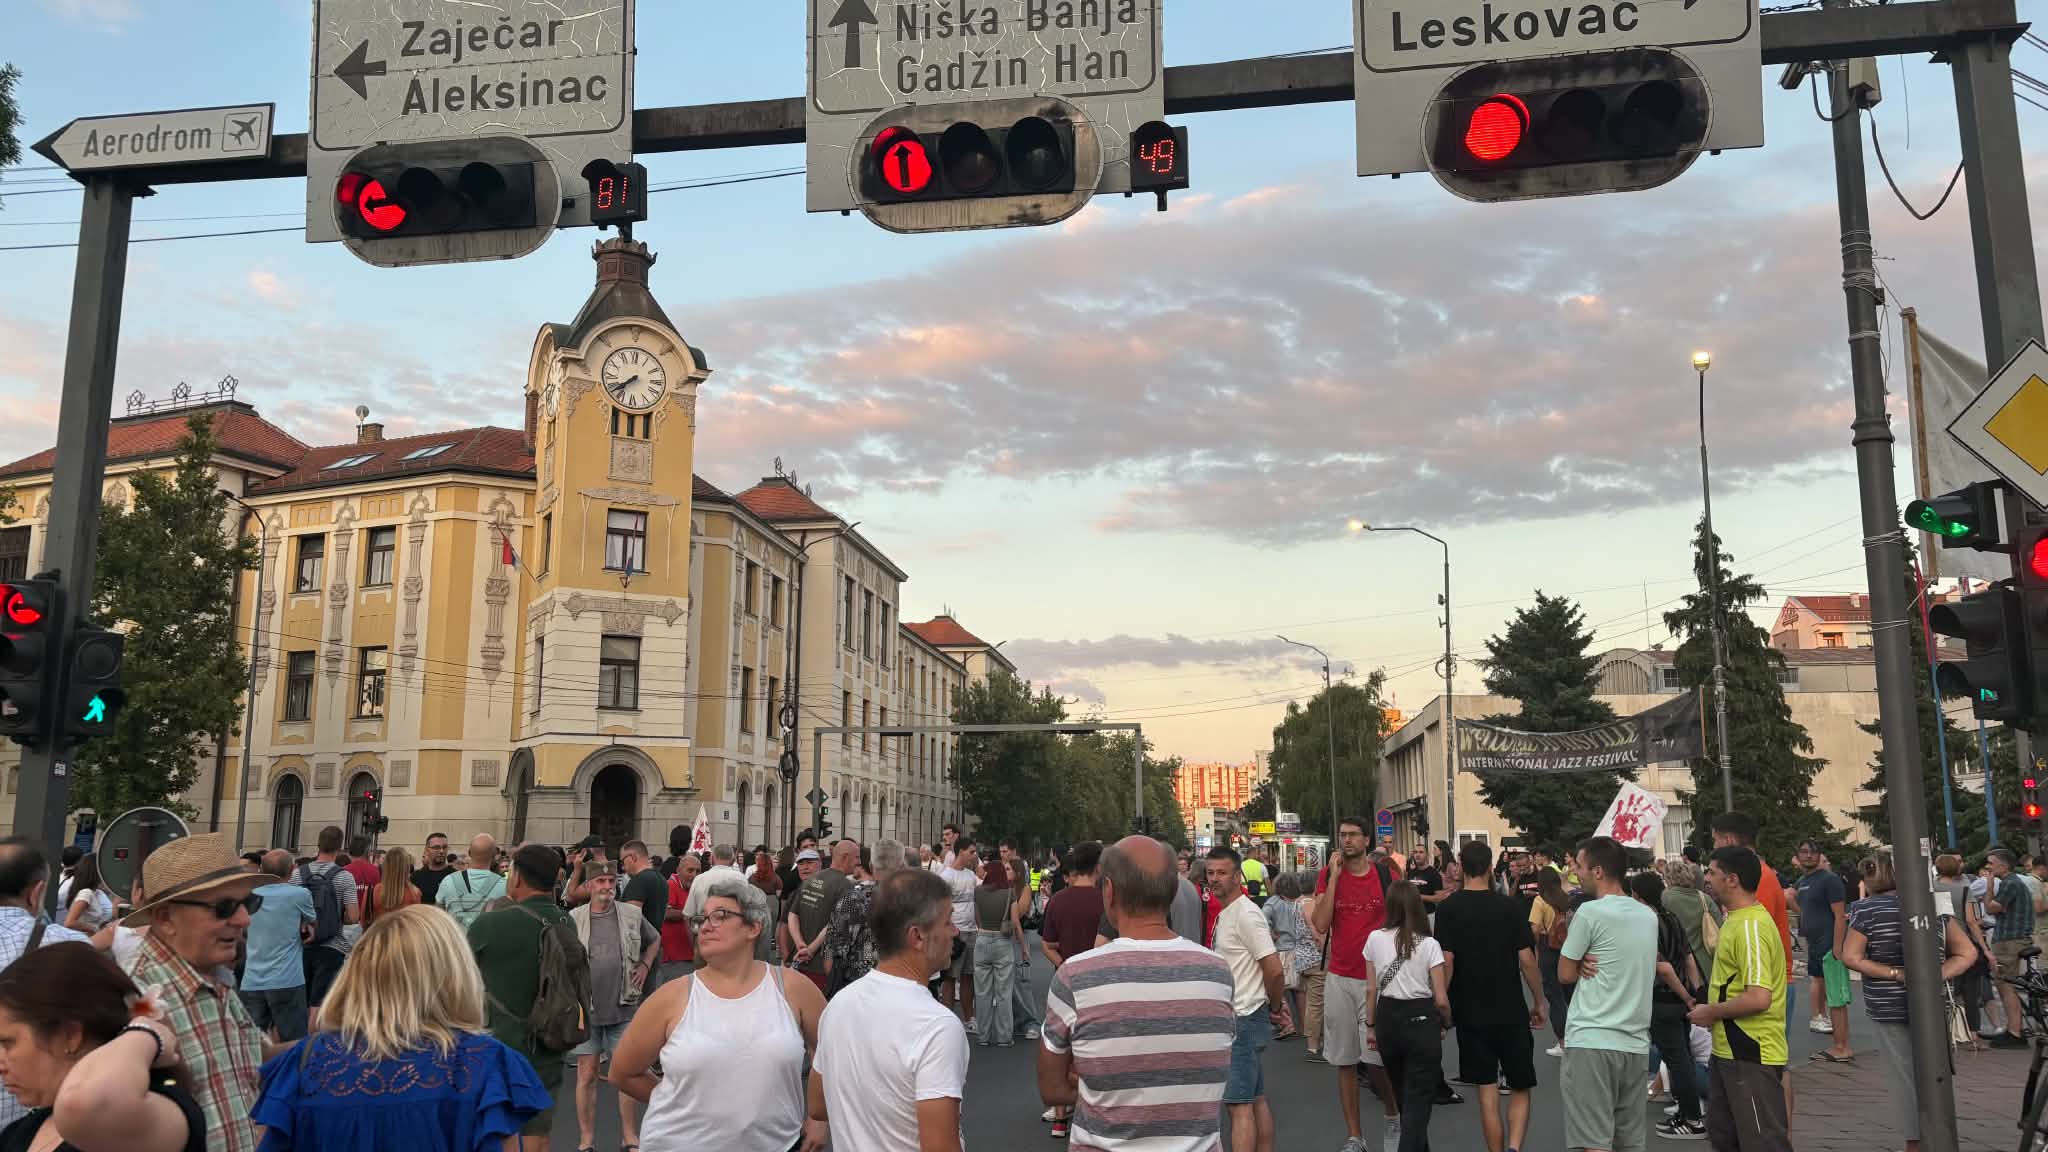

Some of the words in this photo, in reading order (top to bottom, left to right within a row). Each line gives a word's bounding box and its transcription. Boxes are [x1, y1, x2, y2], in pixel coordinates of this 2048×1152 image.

[401, 16, 564, 63] Zaječar
[896, 0, 998, 41] Niška
[1027, 0, 1136, 36] Banja
[1392, 1, 1639, 51] Leskovac
[897, 50, 1027, 94] Gadžin
[1055, 43, 1128, 83] Han
[401, 72, 607, 115] Aleksinac
[83, 124, 212, 158] Aerodrom
[1139, 138, 1175, 173] 49
[597, 176, 629, 209] 81
[1462, 756, 1549, 769] INTERNATIONAL
[1552, 756, 1583, 769] JAZZ
[1585, 750, 1639, 767] FESTIVAL
[1909, 915, 1930, 931] 14
